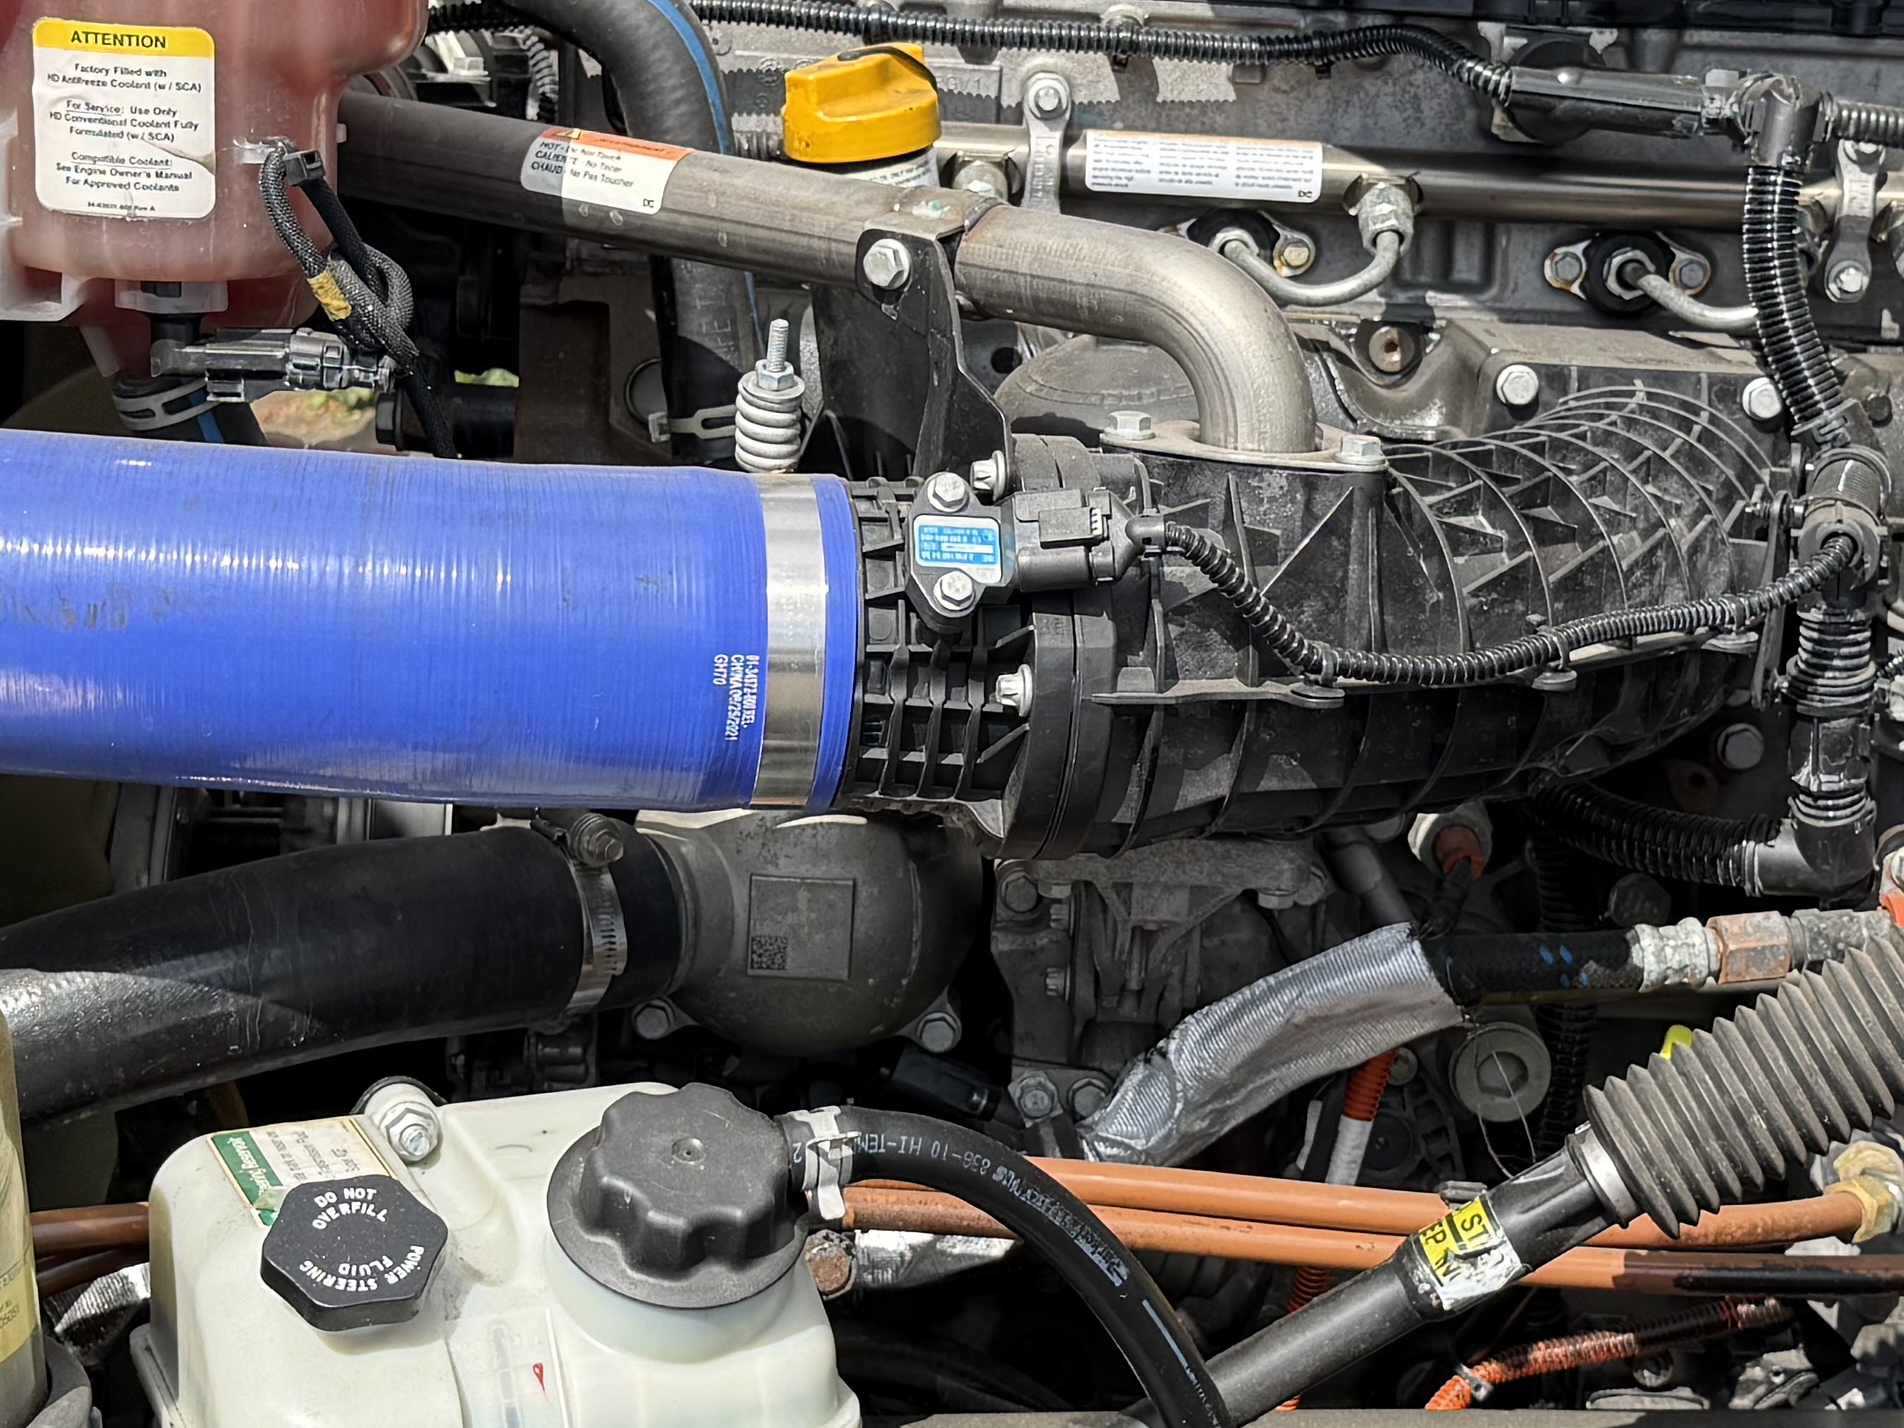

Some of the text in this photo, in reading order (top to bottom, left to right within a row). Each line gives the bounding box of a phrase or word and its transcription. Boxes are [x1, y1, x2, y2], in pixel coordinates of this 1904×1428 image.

[70, 30, 166, 48] ATTENTION
[75, 63, 167, 78] Factory Filled with
[47, 74, 59, 82] HD
[111, 79, 151, 90] Coolant
[176, 83, 201, 93] SCA)
[66, 100, 81, 110] For
[130, 106, 150, 115] Use
[153, 108, 178, 117] Only
[50, 112, 62, 121] HD
[130, 119, 171, 129] Coolant
[70, 127, 124, 139] Formulated
[148, 133, 174, 143] SCA)
[71, 152, 125, 165] Compatible
[56, 163, 192, 180] See Engine Owner's Manual
[66, 177, 179, 192] For Approved Coolants
[643, 198, 654, 208] DC
[851, 1133, 922, 1156] HI-TEM
[314, 1188, 377, 1208] DO NOT
[312, 1201, 388, 1230] OVERFILL
[299, 1245, 424, 1292] POWER STEERING
[338, 1255, 394, 1276] FLUID
